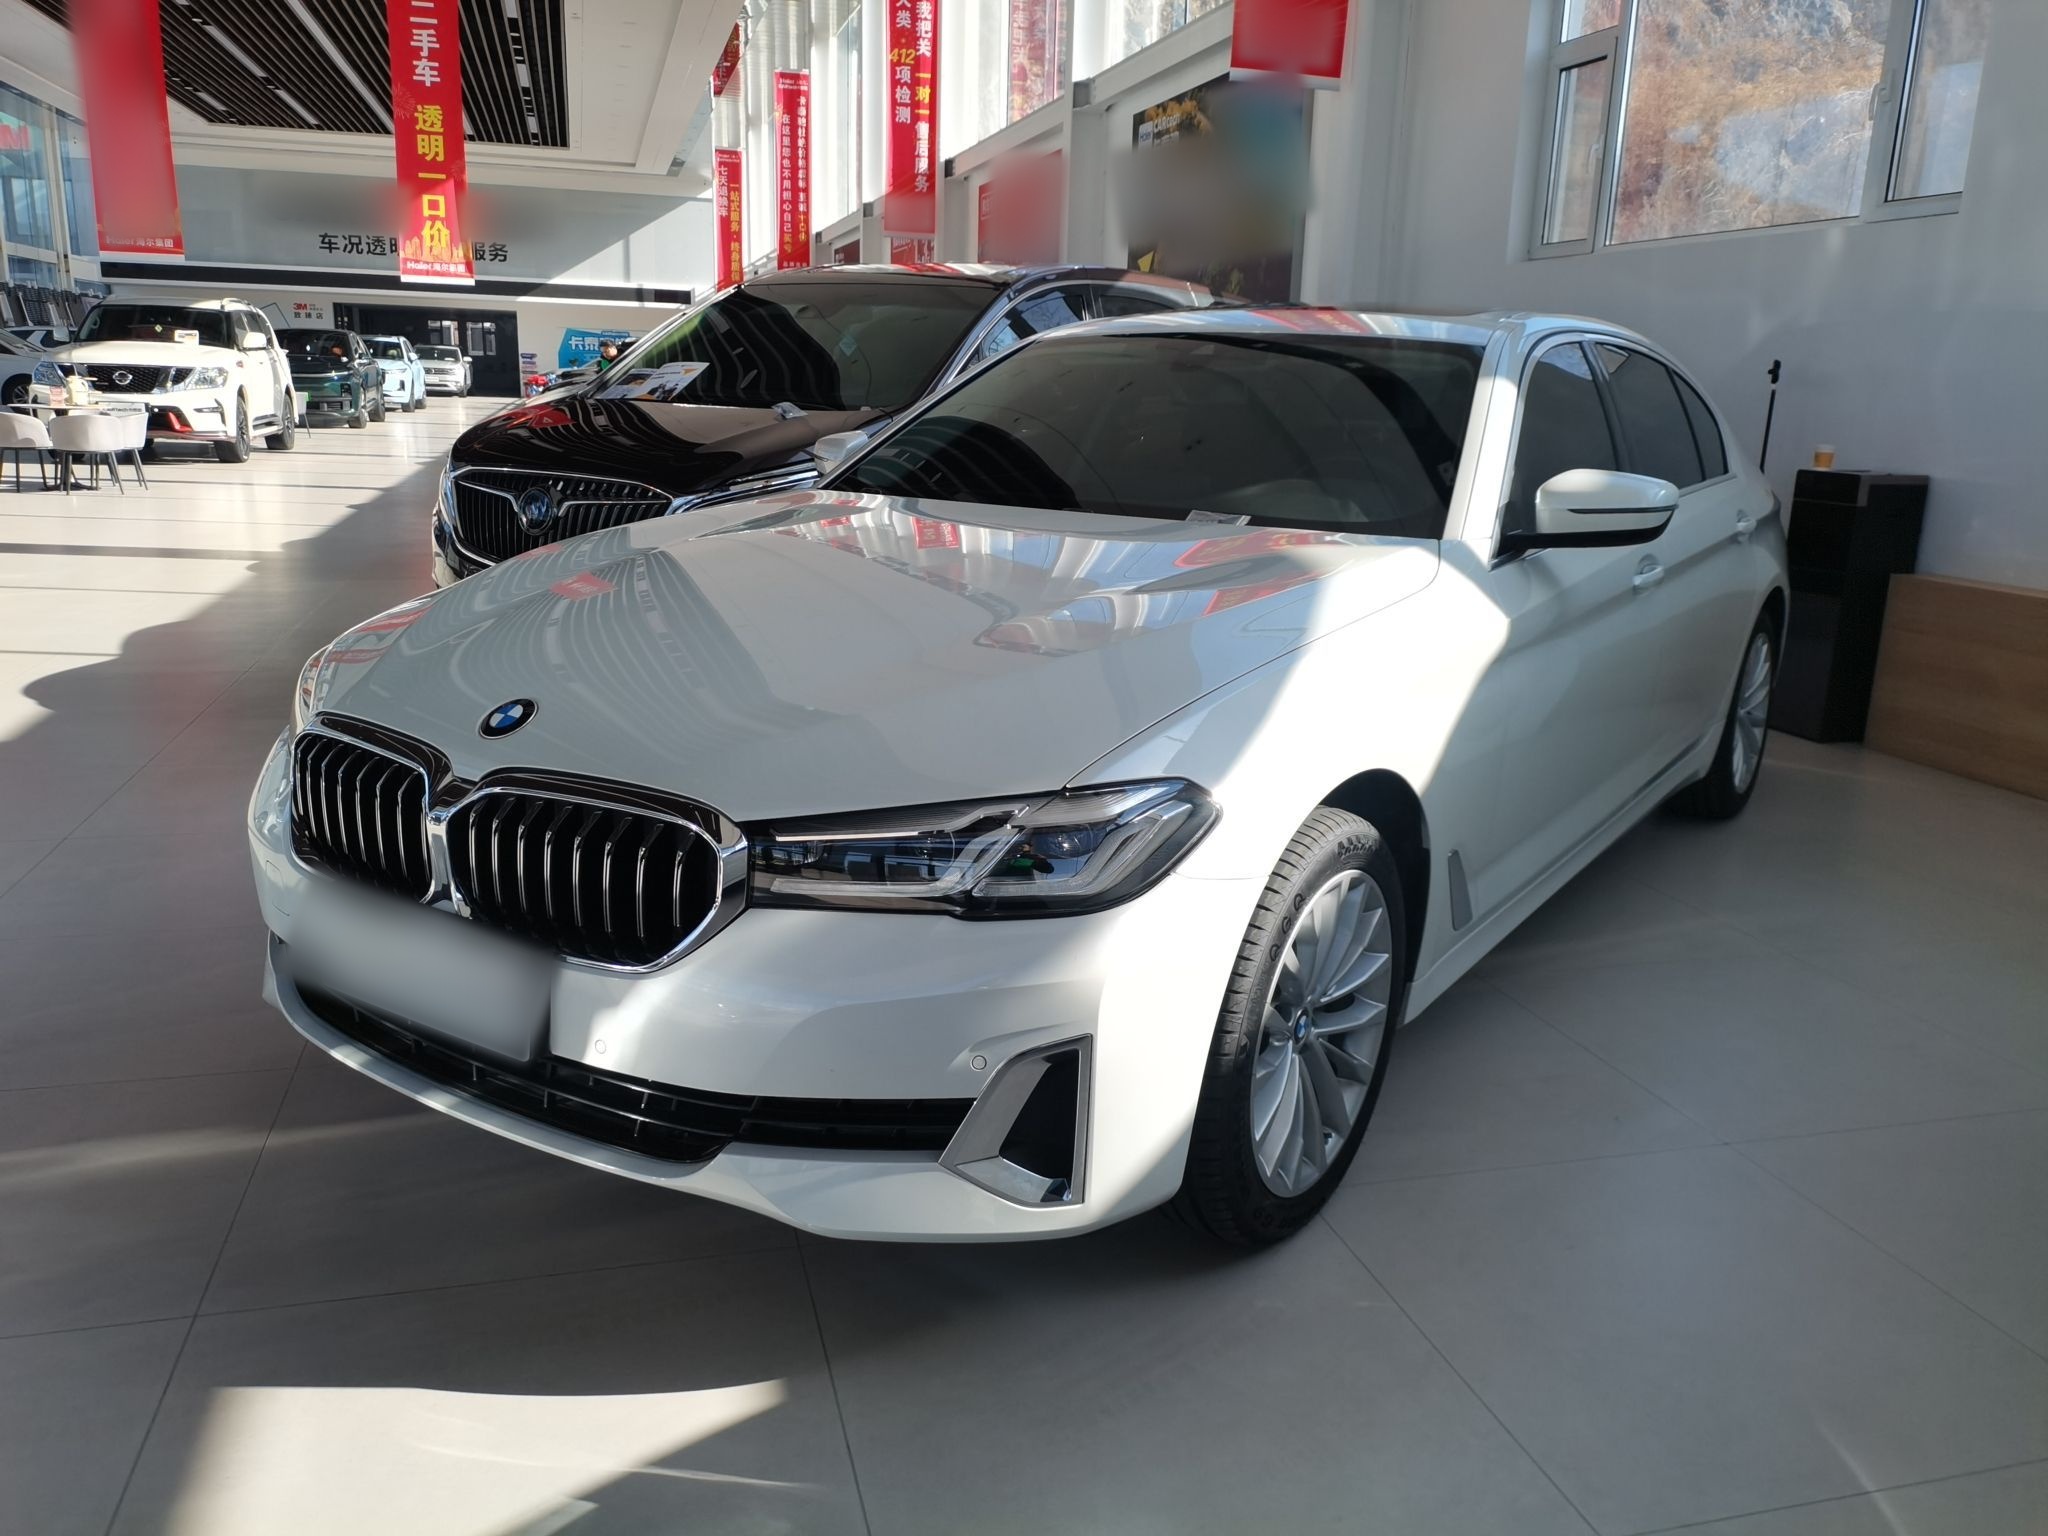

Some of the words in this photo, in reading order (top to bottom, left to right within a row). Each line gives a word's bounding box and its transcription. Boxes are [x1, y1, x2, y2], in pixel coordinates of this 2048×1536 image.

[410, 0, 440, 87] 二手车
[414, 104, 450, 247] 透明一口价
[293, 303, 308, 311] 3M
